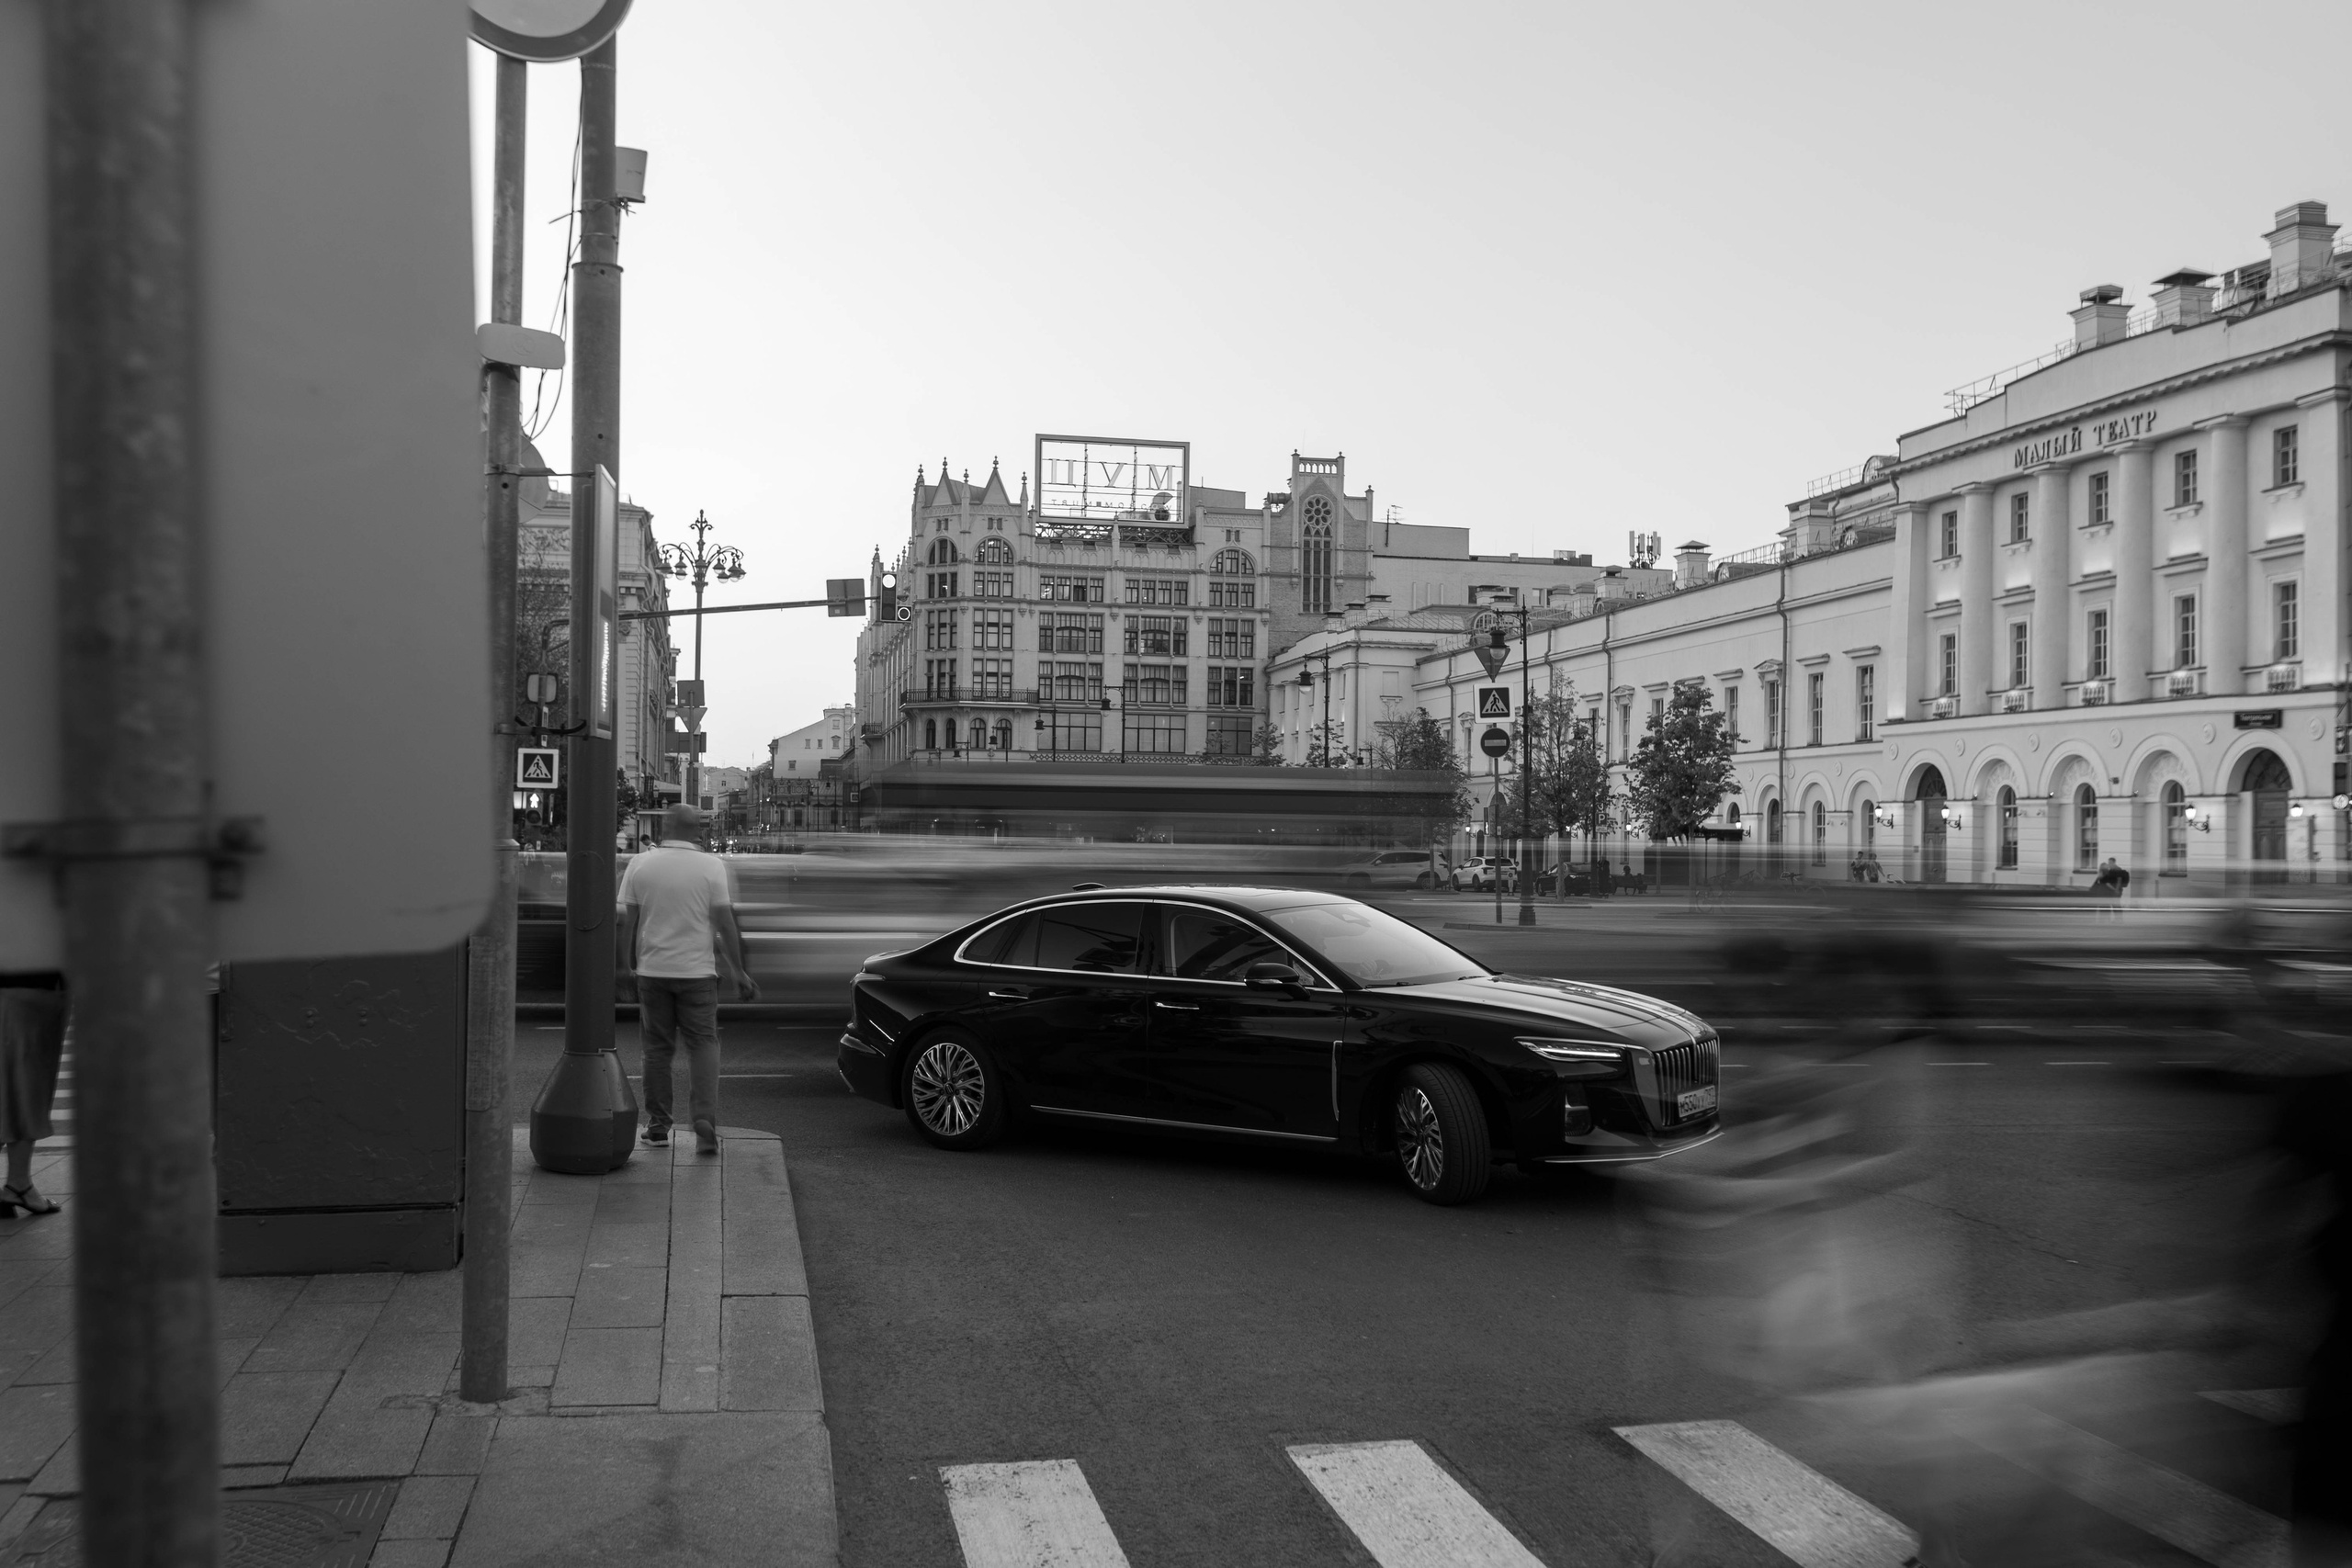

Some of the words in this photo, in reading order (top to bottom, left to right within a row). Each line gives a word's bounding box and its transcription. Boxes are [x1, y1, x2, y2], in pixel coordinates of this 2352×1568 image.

[2015, 426, 2082, 468] МАЛЫЙ
[2093, 410, 2157, 446] ТЕАТР
[1048, 458, 1175, 491] ЦУМ
